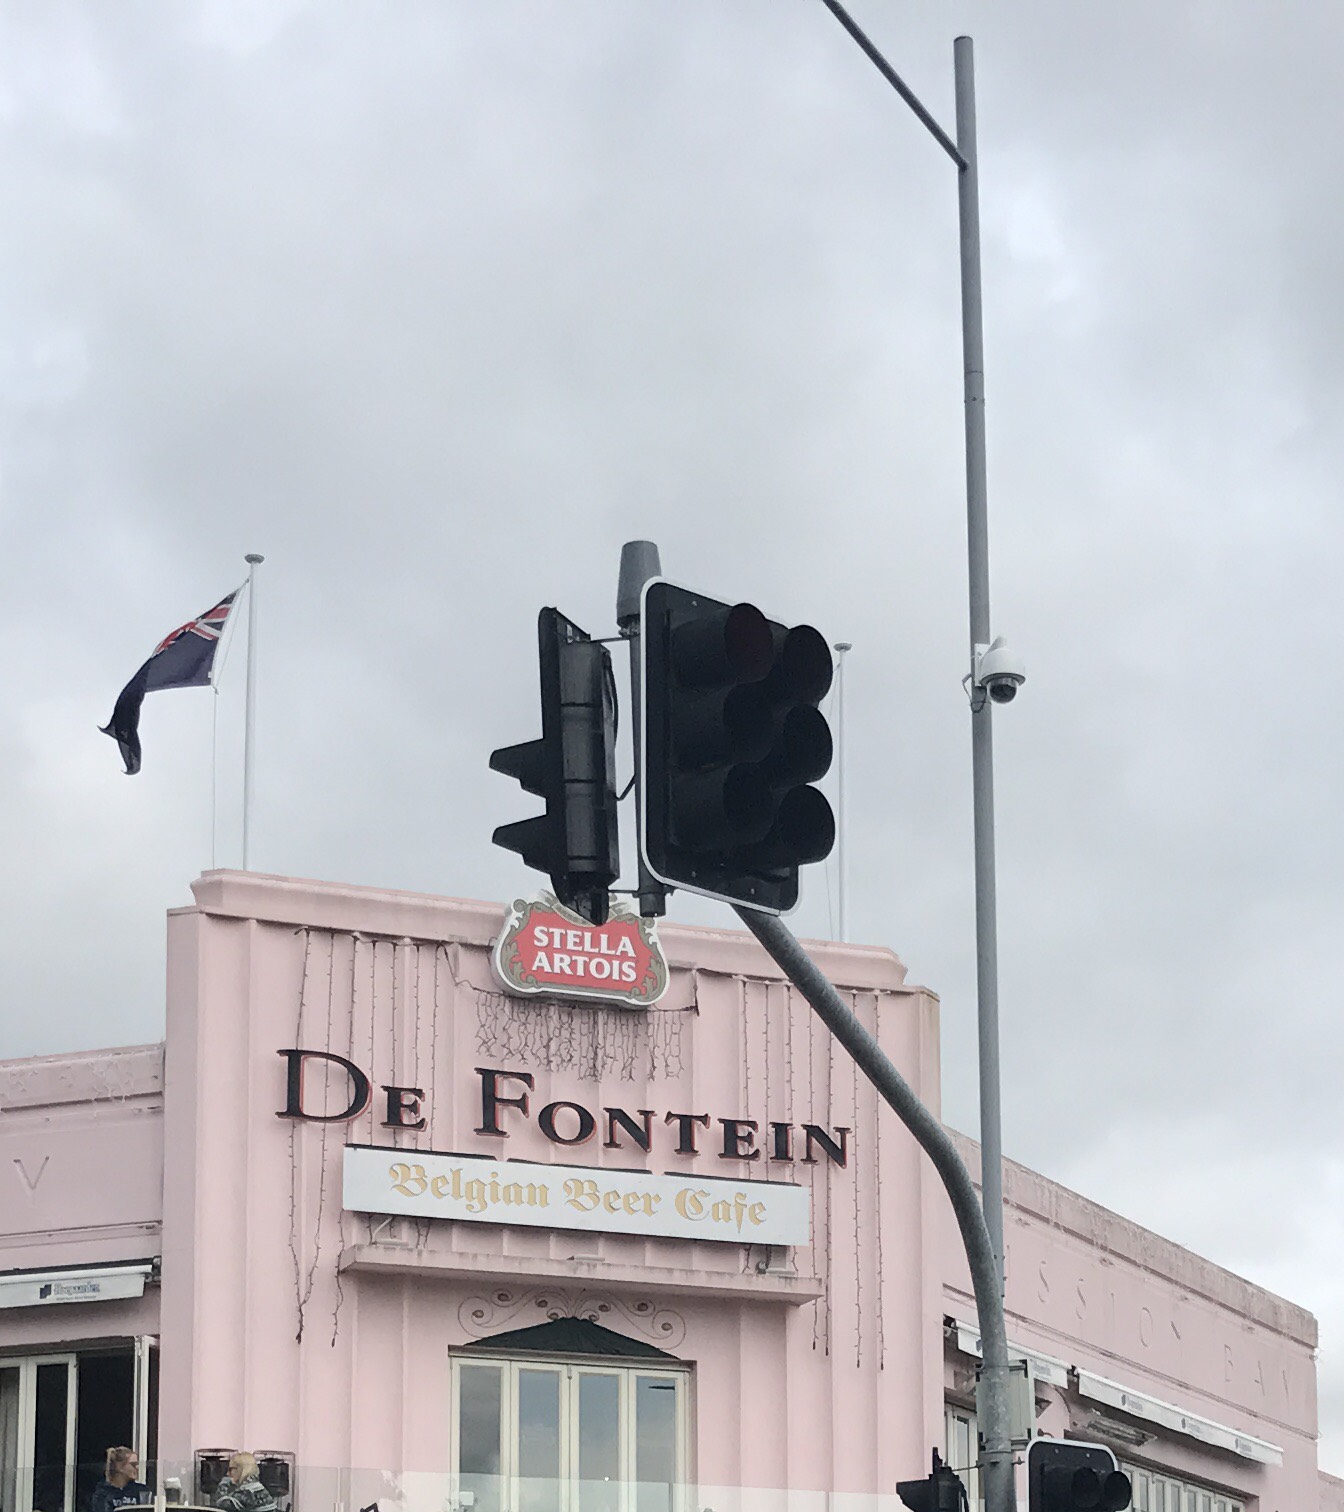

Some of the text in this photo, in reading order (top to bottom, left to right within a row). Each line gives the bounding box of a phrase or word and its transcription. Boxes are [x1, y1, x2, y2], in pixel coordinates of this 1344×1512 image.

[531, 951, 637, 982] ARTOIS
[533, 925, 637, 958] STELLA
[275, 1048, 852, 1170] DE FONTEIN
[388, 1162, 767, 1234] Belgian Beer Cafe
